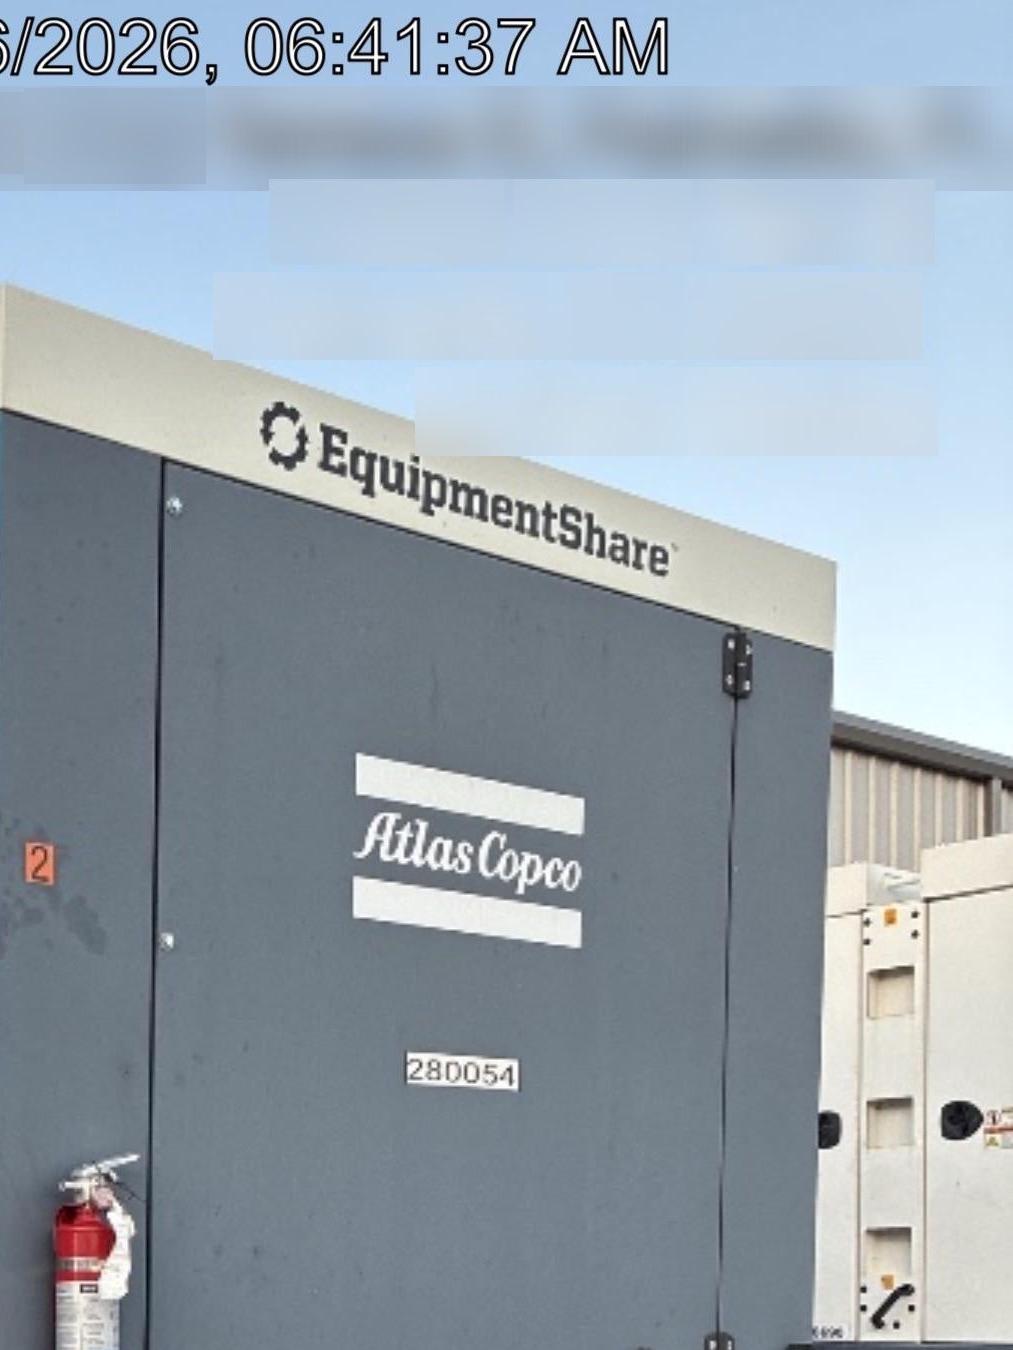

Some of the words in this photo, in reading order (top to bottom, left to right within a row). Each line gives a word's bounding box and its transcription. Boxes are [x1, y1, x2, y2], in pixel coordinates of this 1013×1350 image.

[319, 421, 670, 577] EquipmentShare
[31, 845, 50, 883] 2
[352, 811, 474, 875] Atlas
[477, 829, 583, 896] Copco
[407, 1057, 516, 1087] 280054
